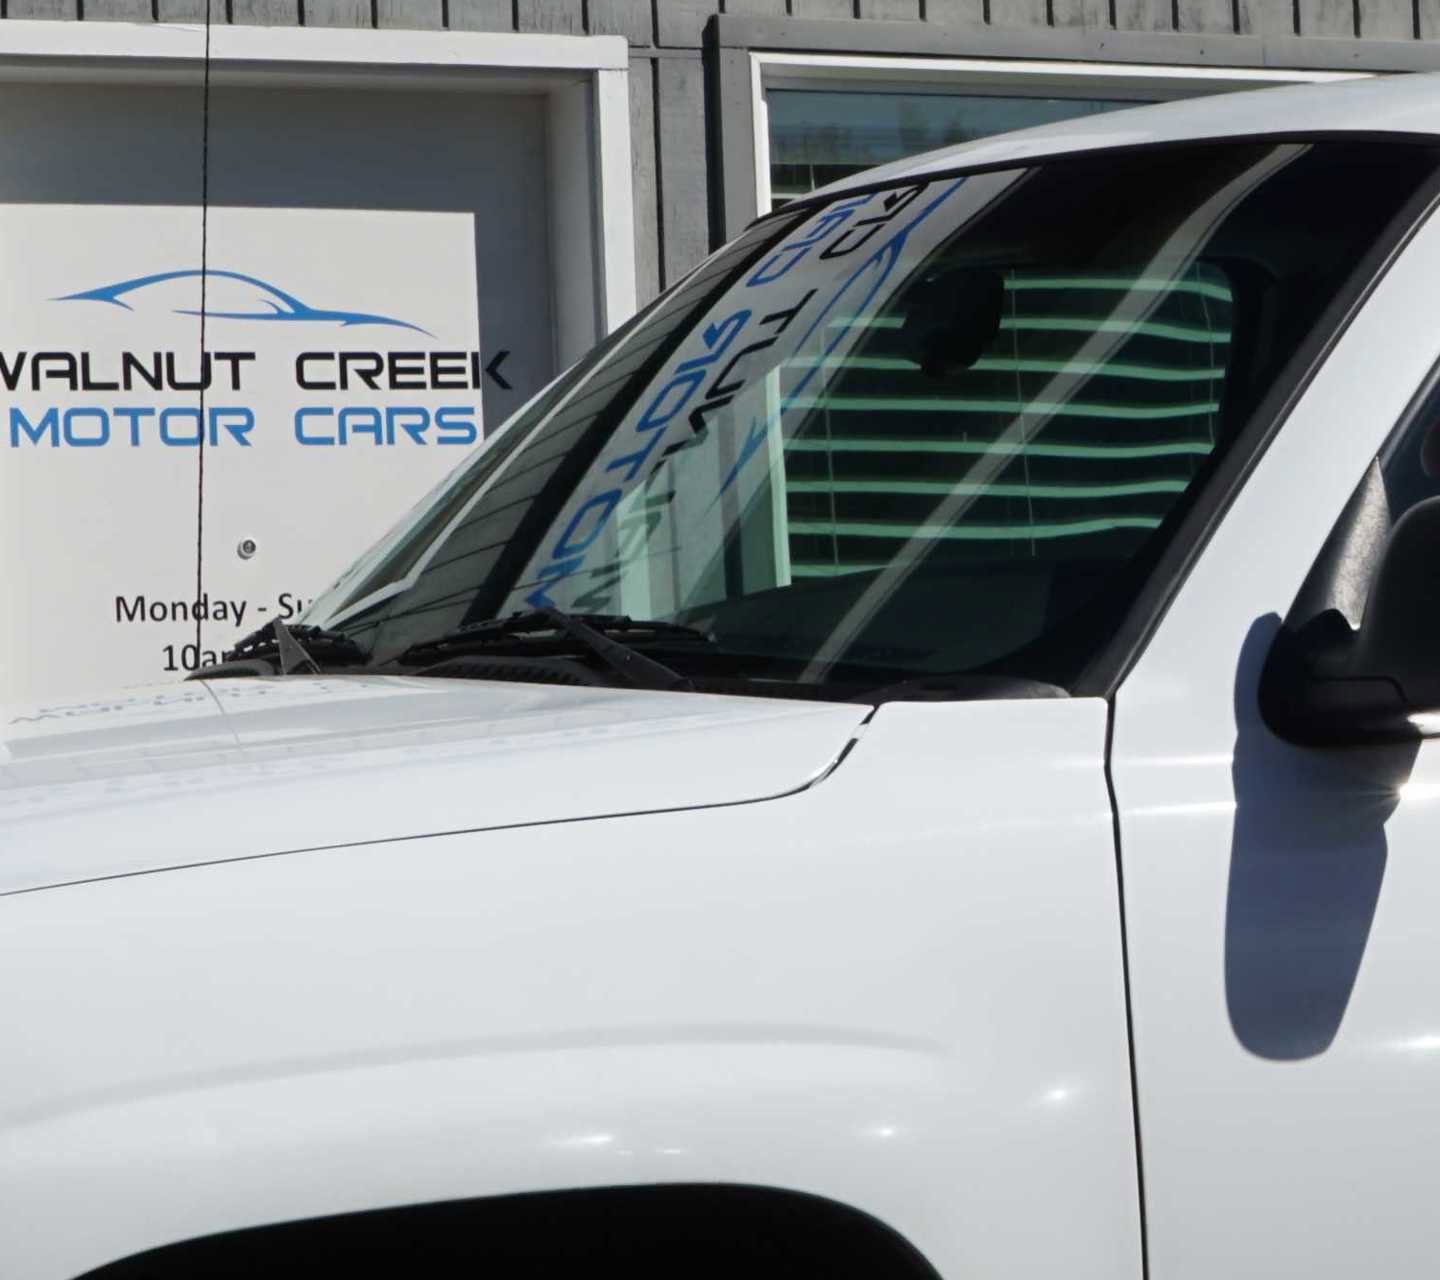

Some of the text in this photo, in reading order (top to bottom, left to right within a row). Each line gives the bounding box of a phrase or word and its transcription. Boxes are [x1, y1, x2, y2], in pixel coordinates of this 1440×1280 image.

[295, 351, 513, 390] CREEK
[10, 406, 477, 447] MOTOR CARS
[115, 592, 247, 627] Monday
